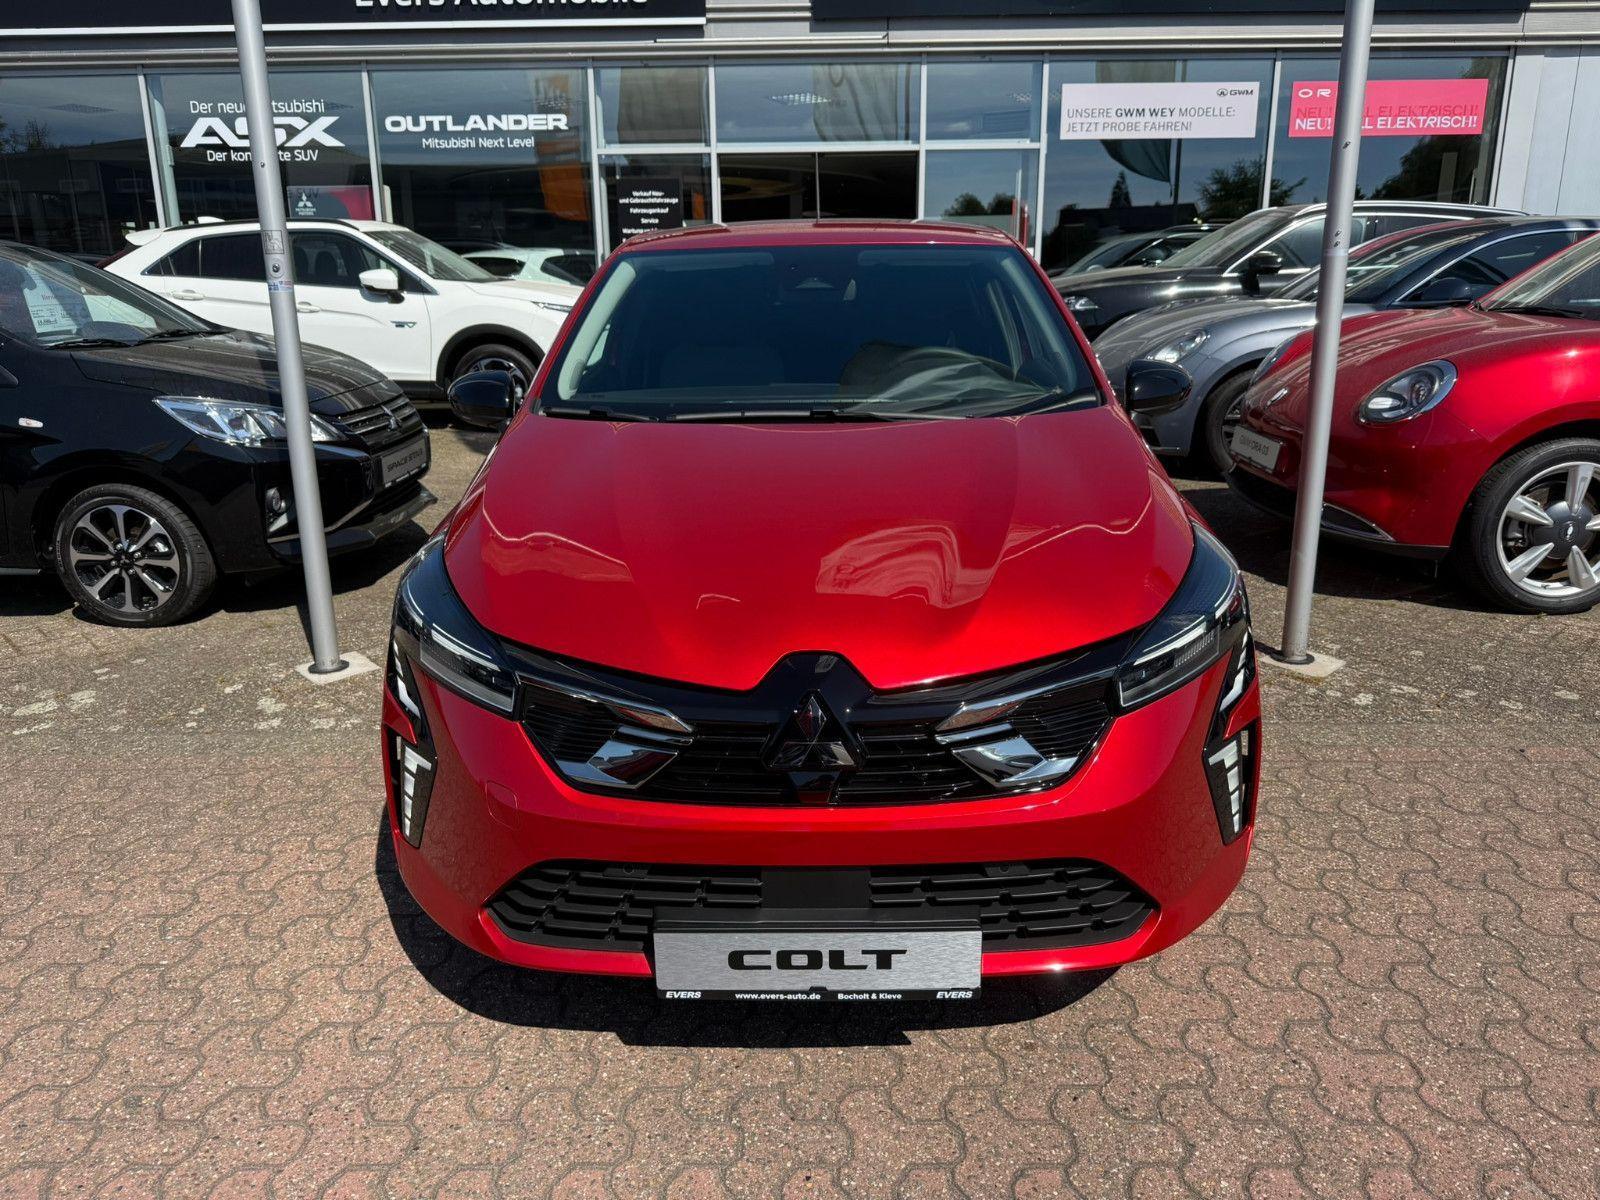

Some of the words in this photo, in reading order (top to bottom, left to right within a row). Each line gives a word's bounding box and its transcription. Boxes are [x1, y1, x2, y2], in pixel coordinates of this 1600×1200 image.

[1298, 88, 1332, 98] OR
[189, 100, 213, 114] Der
[270, 99, 325, 113] tsubishi
[1066, 107, 1112, 119] UNSERE
[1114, 107, 1146, 118] GWM
[1149, 107, 1176, 118] WEY
[1178, 106, 1236, 118] MODELLE:
[384, 113, 569, 132] OUTLANDER
[1066, 121, 1100, 133] JETZT
[1102, 121, 1141, 132] PROBE
[1143, 121, 1192, 132] FAHREN!
[1294, 117, 1332, 130] NEU!
[1376, 116, 1478, 129] ELEKTRISCH!
[180, 116, 346, 148] ASX
[422, 136, 476, 149] Mitsubishi
[478, 137, 505, 148] Next
[506, 136, 535, 148] Level
[206, 150, 228, 162] Der
[294, 149, 319, 161] SUV
[727, 949, 908, 970] COLT
[665, 991, 702, 999] EVERS
[734, 992, 821, 1000] www.evers-auto.de
[837, 992, 870, 1000] Bocholt
[870, 992, 878, 1000] &
[878, 992, 902, 1000] Kleve
[935, 990, 973, 999] EVERS
